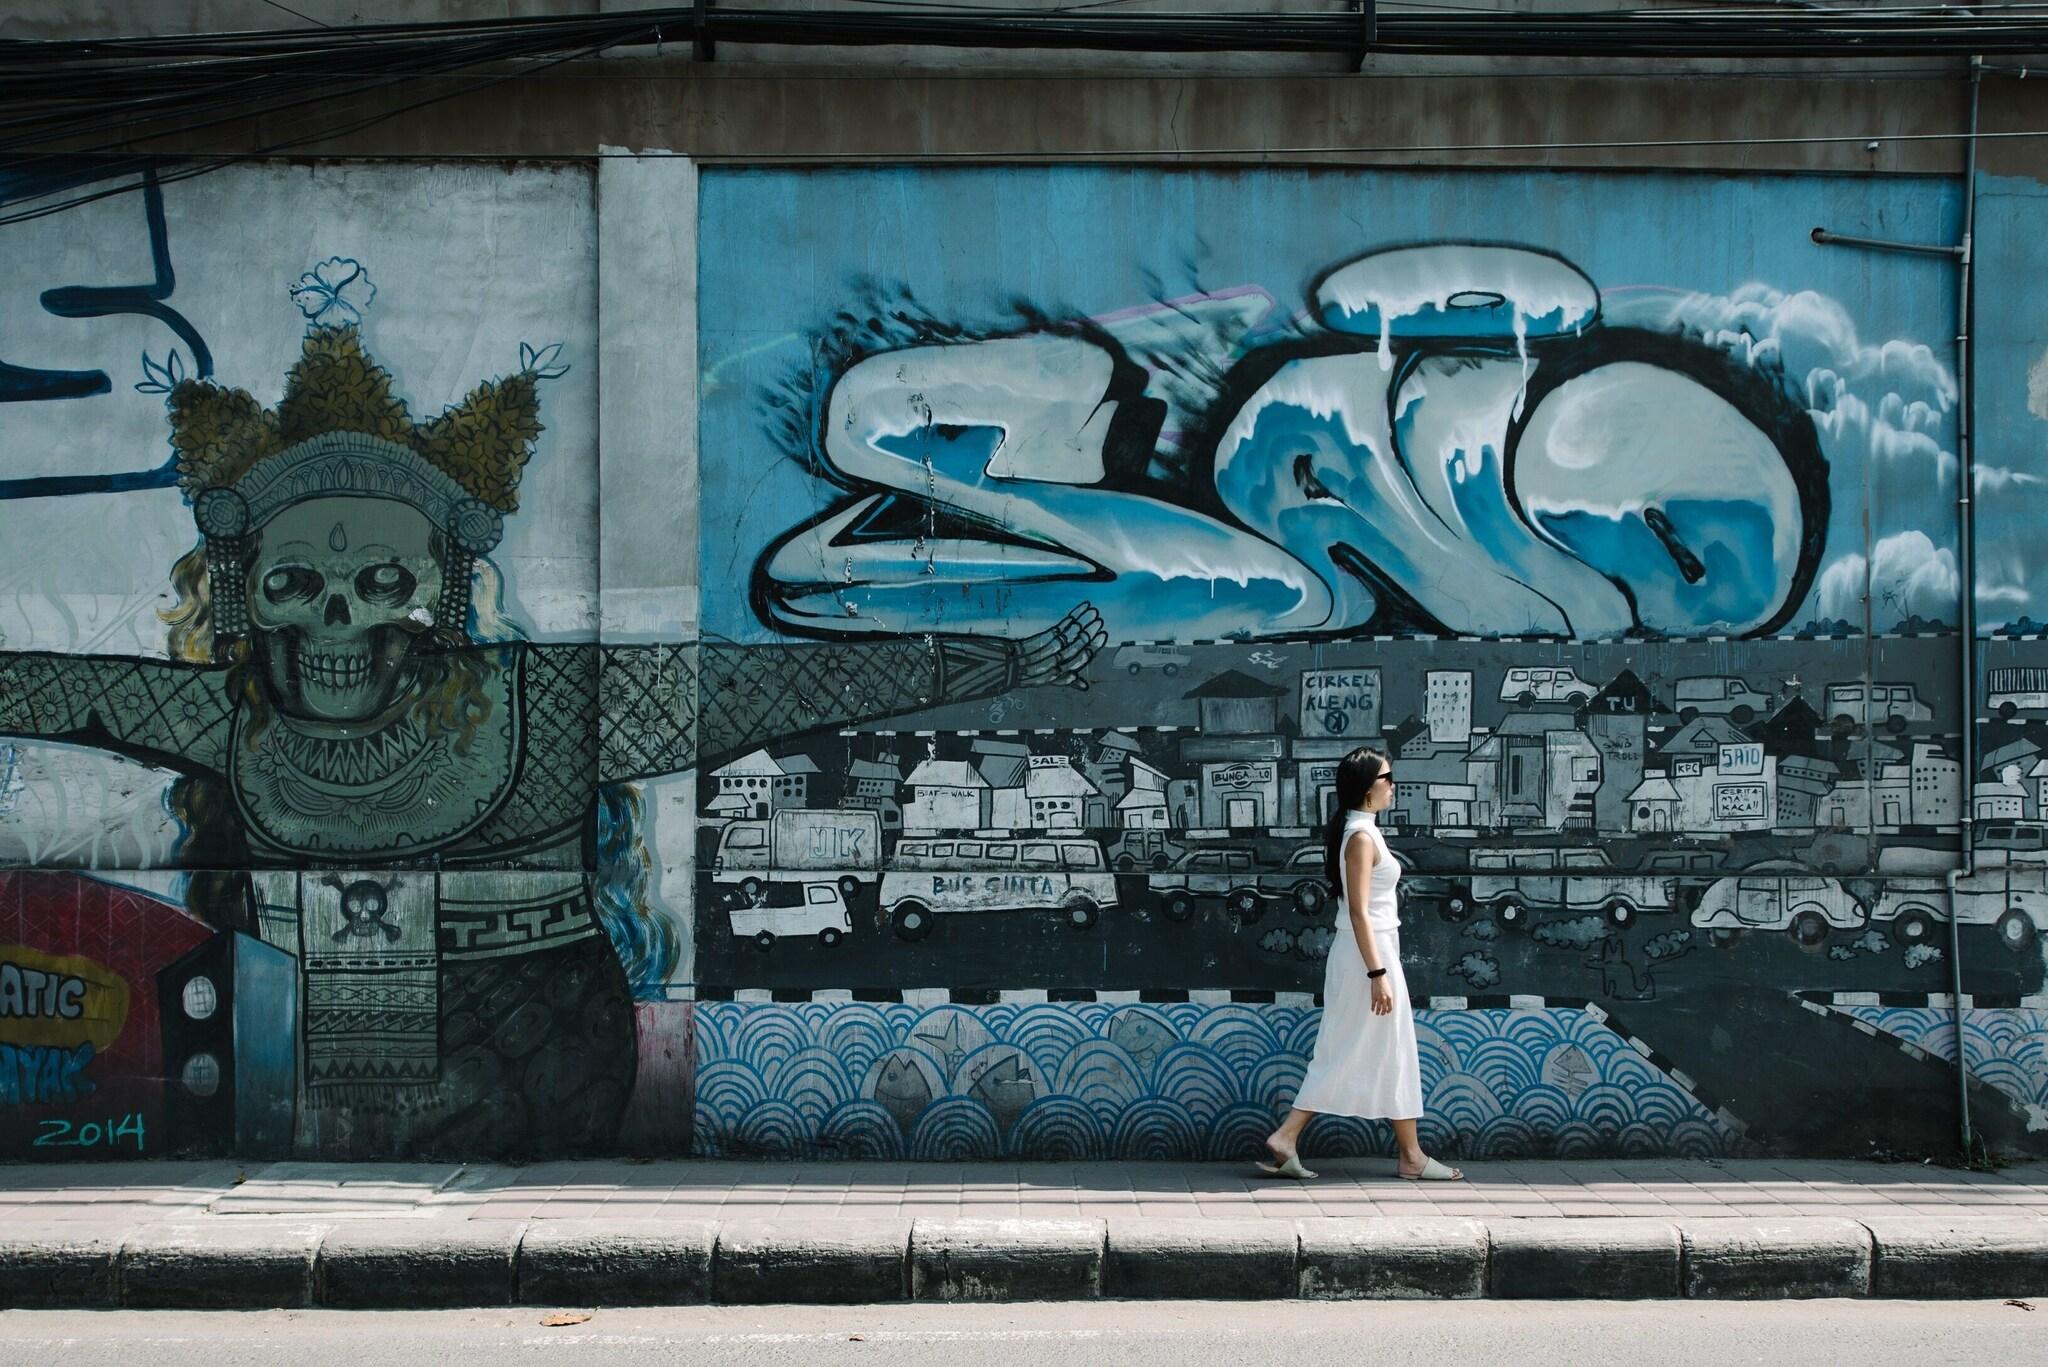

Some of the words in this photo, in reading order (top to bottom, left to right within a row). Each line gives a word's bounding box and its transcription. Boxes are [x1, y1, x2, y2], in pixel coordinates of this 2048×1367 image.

[1305, 673, 1376, 689] CIRKEL
[1305, 694, 1373, 711] KLENG
[1032, 756, 1067, 766] SALE
[33, 1112, 145, 1151] 2014
